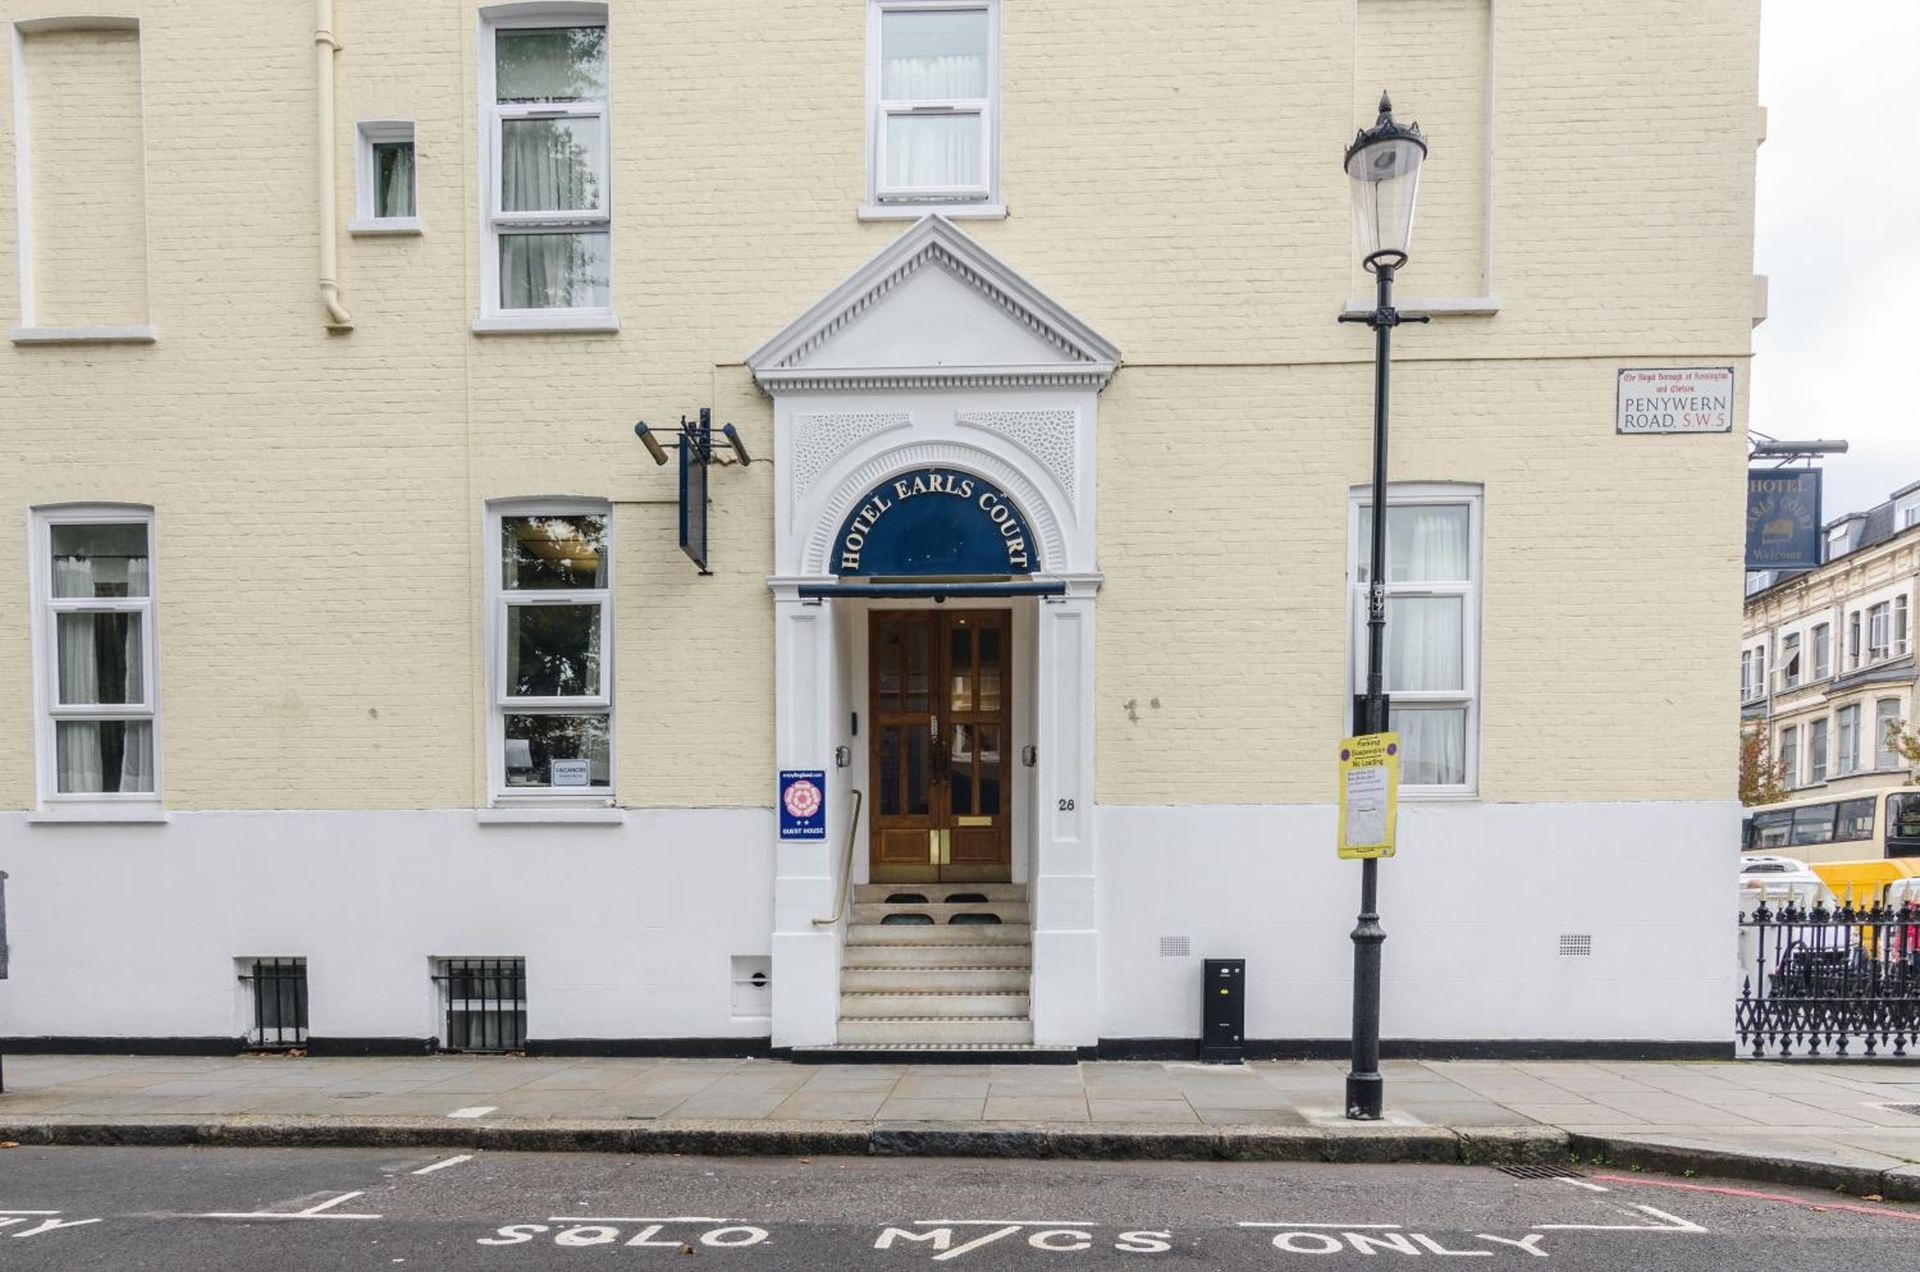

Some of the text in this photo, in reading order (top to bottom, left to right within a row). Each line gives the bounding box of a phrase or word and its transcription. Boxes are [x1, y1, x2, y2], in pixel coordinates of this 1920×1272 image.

[1658, 373, 1683, 383] Borough
[1686, 373, 1692, 381] of
[1625, 397, 1726, 412] PENYWERN
[1750, 480, 1808, 492] HOTEL
[841, 474, 1028, 570] HOTEL EARLS COURT
[1753, 549, 1803, 560] Welcome
[1058, 798, 1075, 811] 28
[782, 827, 802, 835] GUEST
[476, 1224, 769, 1246] SOLO
[1272, 1231, 1550, 1256] ONLY
